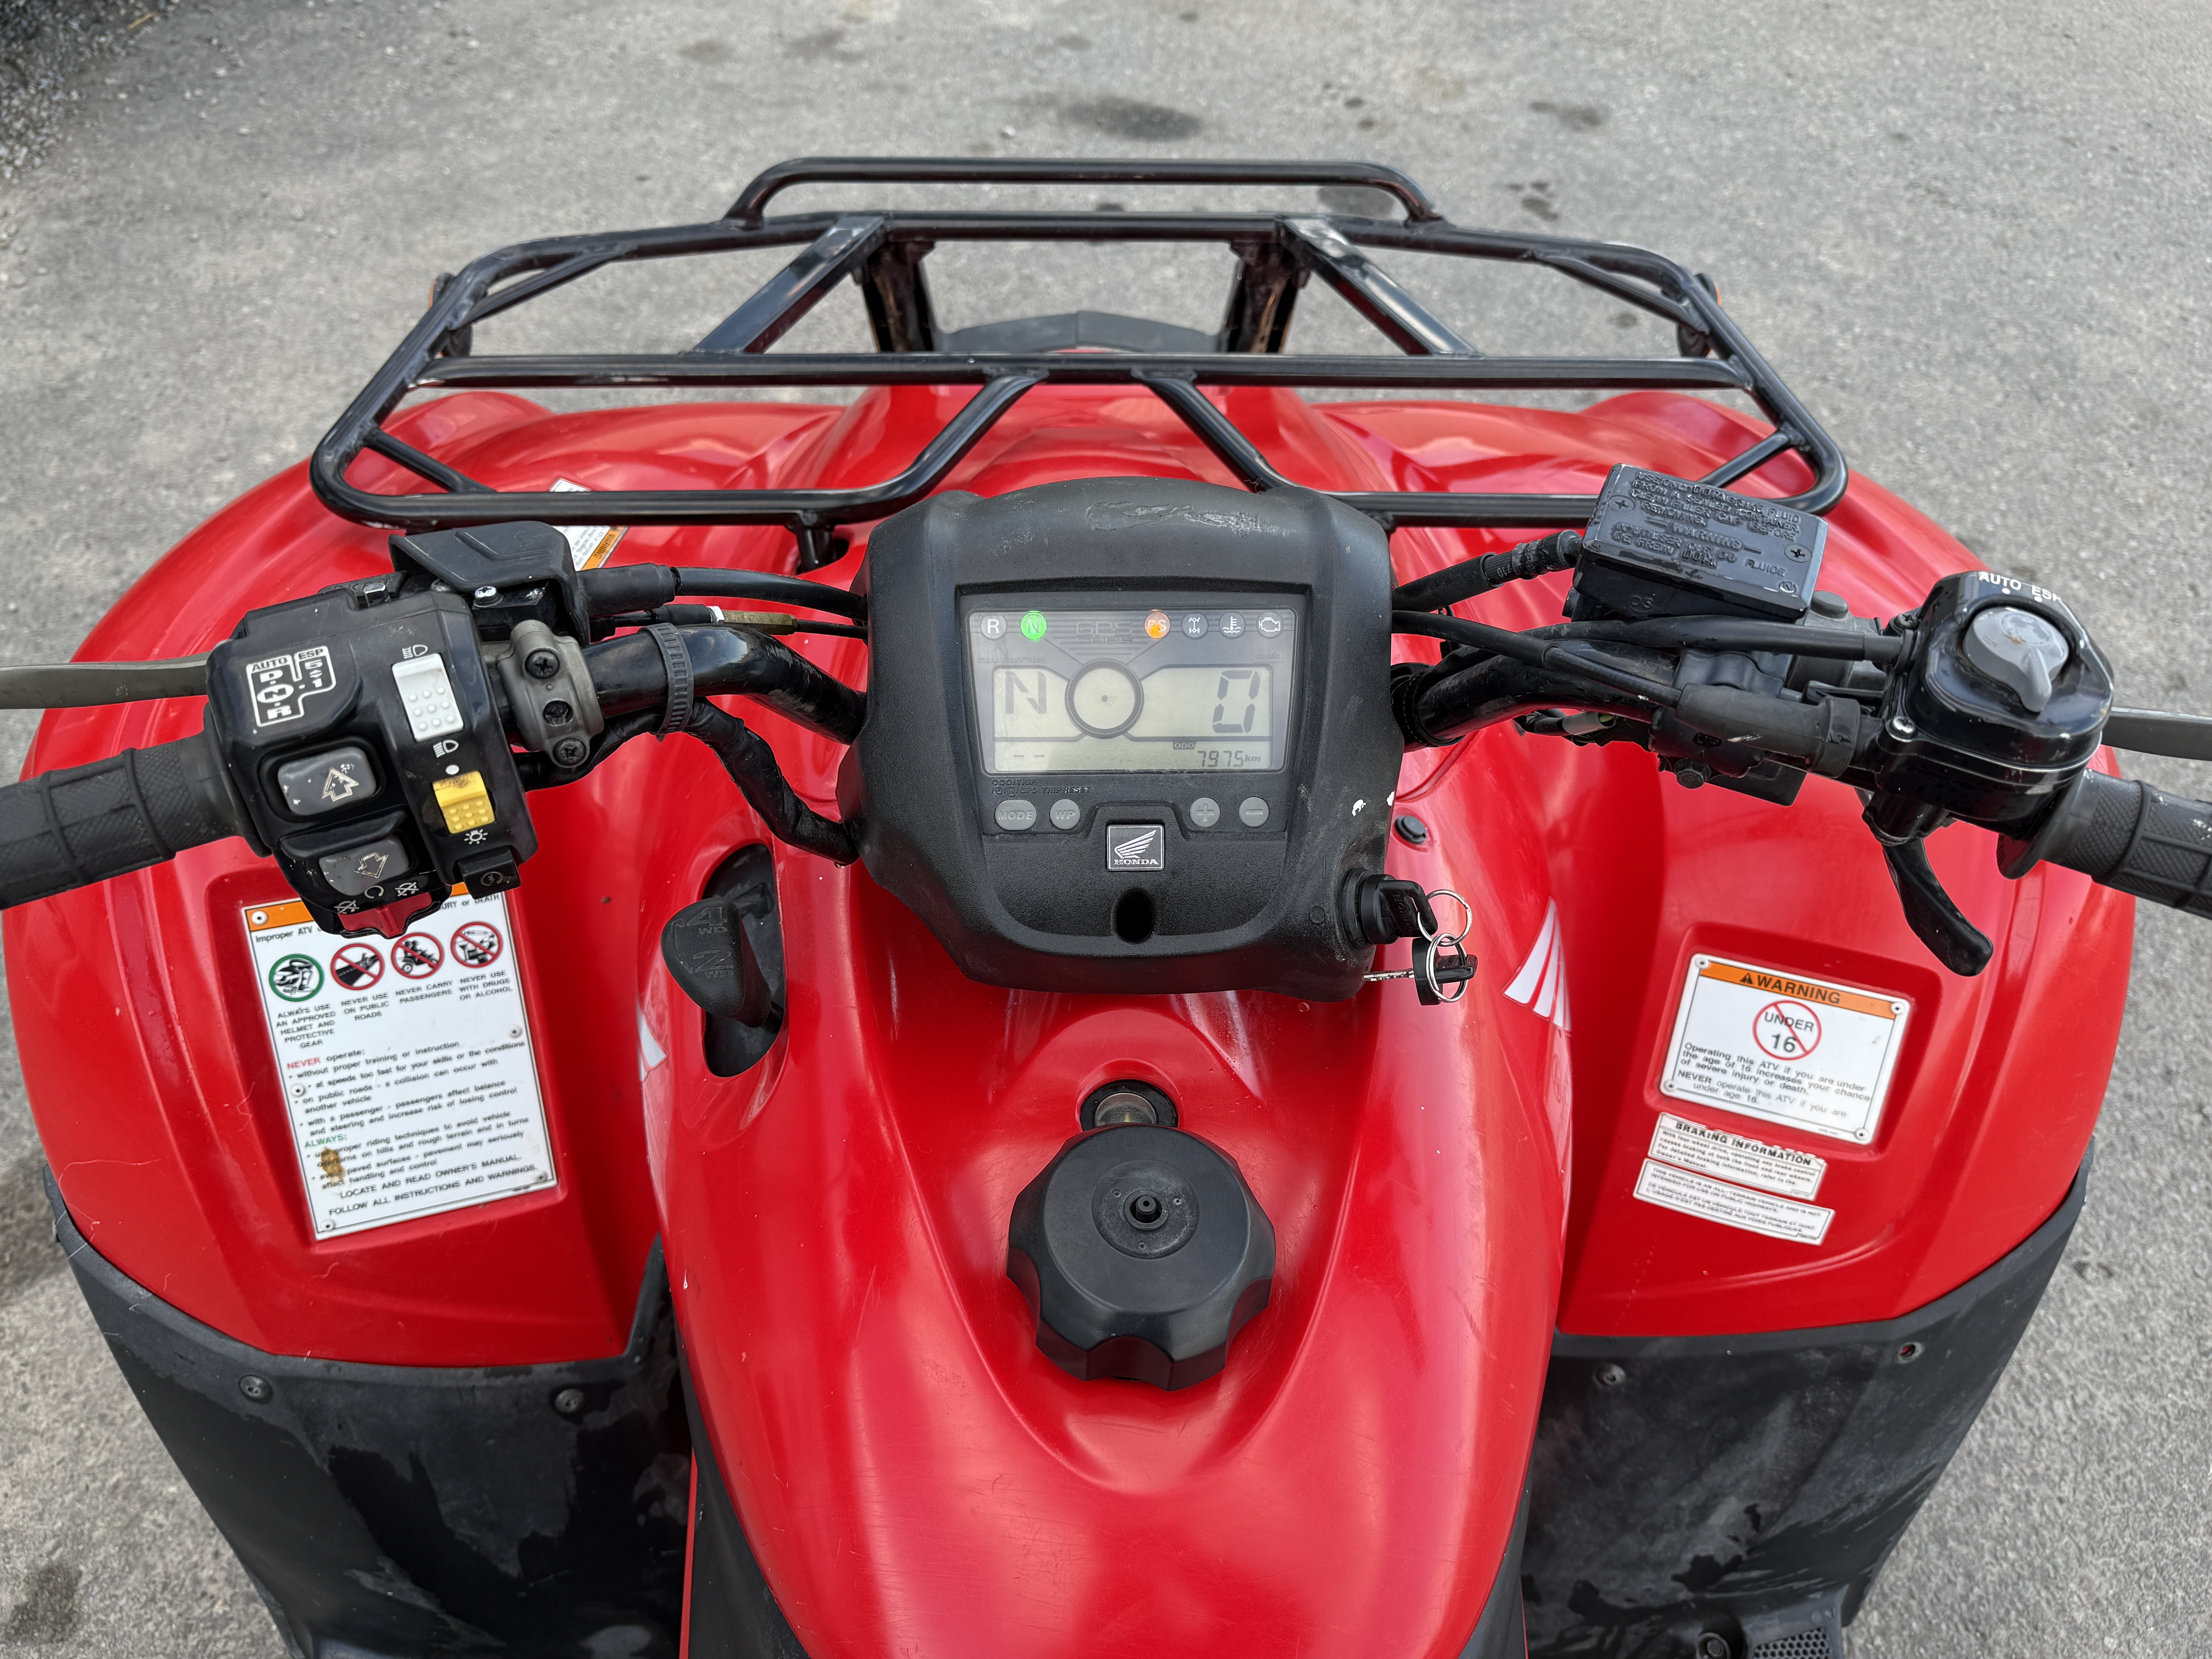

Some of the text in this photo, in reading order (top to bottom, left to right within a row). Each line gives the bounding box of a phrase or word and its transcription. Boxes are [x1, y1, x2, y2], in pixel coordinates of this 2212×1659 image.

[1766, 507, 1801, 523] FLUID
[1668, 522, 1744, 550] WARNING
[1748, 520, 1797, 542] BEFORE
[1744, 558, 1787, 577] FLUIDE
[1979, 572, 2021, 591] AUTO
[988, 618, 1000, 634] R
[1027, 618, 1040, 633] N
[1075, 620, 1133, 636] GPS
[298, 648, 324, 659] ESP
[252, 657, 288, 672] AUTO
[304, 659, 323, 670] 5
[259, 670, 283, 683] D
[312, 678, 323, 688] 1
[264, 687, 287, 700] N
[1005, 671, 1048, 715] N
[1212, 670, 1261, 733] 0
[267, 705, 292, 720] R
[1197, 750, 1244, 767] 7975
[998, 810, 1034, 820] MODE
[1054, 810, 1076, 819] WP
[255, 925, 314, 945] Improper ATV
[460, 969, 507, 984] NEVER USE
[395, 979, 453, 996] NEVER CARRY
[459, 977, 510, 993] WITH DRUGS
[459, 985, 513, 1001] OR ALCOHOL
[1755, 974, 1842, 1005] WARNING
[340, 991, 388, 1006] NEVER USE
[399, 988, 453, 1004] PASSENGERS
[276, 1003, 331, 1018] ALWAYS USE
[359, 1000, 390, 1012] PUBLIC
[291, 1011, 337, 1024] APPROVED
[353, 1010, 383, 1021] ROADS
[1763, 1011, 1815, 1033] UNDER
[280, 1019, 335, 1036] HELMET AND
[283, 1028, 335, 1044] PROTECTIVE
[299, 1039, 324, 1049] GEAR
[1769, 1032, 1798, 1054] 16
[286, 1056, 321, 1071] NEVER
[296, 1066, 329, 1079] without
[332, 1061, 362, 1073] proper
[365, 1053, 398, 1067] training
[414, 1039, 460, 1056] instruction
[315, 1080, 324, 1089] at
[326, 1074, 357, 1087] speeds
[360, 1070, 374, 1079] too
[376, 1066, 392, 1076] fast
[395, 1063, 407, 1072] for
[410, 1060, 429, 1071] your
[432, 1054, 453, 1065] skills
[468, 1049, 481, 1057] the
[484, 1039, 526, 1054] conditions
[1683, 1041, 1865, 1093] Operating this ATV if you are under
[1680, 1057, 1692, 1066] of
[1695, 1061, 1728, 1075] severe
[1731, 1070, 1759, 1084] injury
[1763, 1079, 1775, 1087] or
[1682, 1049, 1699, 1060] the
[1702, 1055, 1720, 1066] age
[1724, 1060, 1736, 1069] of
[1740, 1064, 1752, 1073] 16
[1755, 1068, 1803, 1085] increases
[1807, 1081, 1830, 1093] your
[318, 1089, 345, 1102] public
[348, 1084, 373, 1095] roads
[394, 1072, 430, 1085] collision
[434, 1069, 449, 1077] can
[453, 1063, 477, 1073] occur
[481, 1058, 498, 1067] with
[1677, 1069, 1848, 1118] NEVER operate this ATV if you are
[1693, 1081, 1719, 1094] under
[1723, 1089, 1741, 1101] age
[304, 1094, 372, 1115] another vehicle
[1674, 1121, 1729, 1145] BRAKING
[1731, 1137, 1812, 1168] INFORMATION
[340, 1183, 377, 1199] LOCATE
[380, 1179, 401, 1190] AND
[405, 1172, 431, 1184] READ
[328, 1200, 369, 1216] FOLLOW
[372, 1196, 391, 1206] ALL
[394, 1180, 461, 1202] INSTRUCTIONS
[464, 1175, 484, 1186] AND
